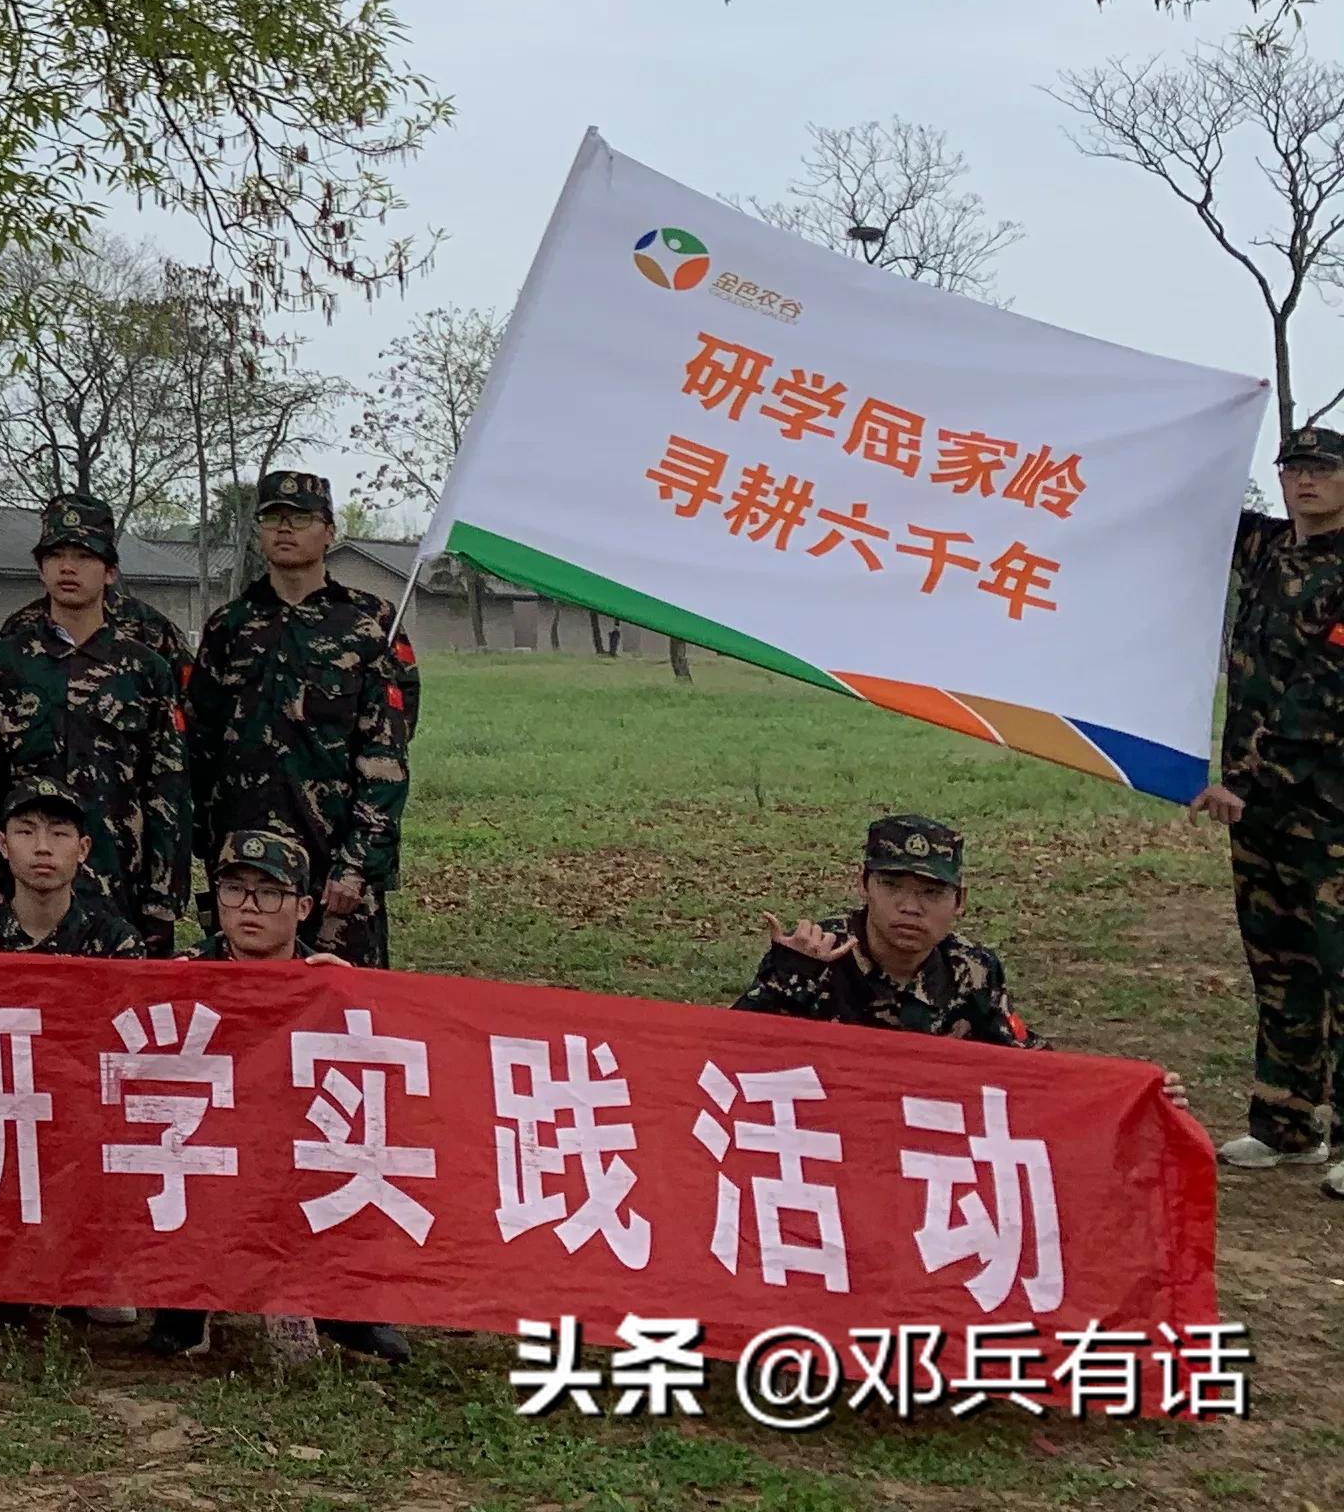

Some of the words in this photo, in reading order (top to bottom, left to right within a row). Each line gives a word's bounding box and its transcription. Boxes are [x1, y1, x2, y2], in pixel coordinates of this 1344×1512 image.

[712, 271, 804, 320] 金色农谷
[681, 330, 1088, 520] 研学屈家岭
[644, 434, 1062, 621] 寻耕六千年
